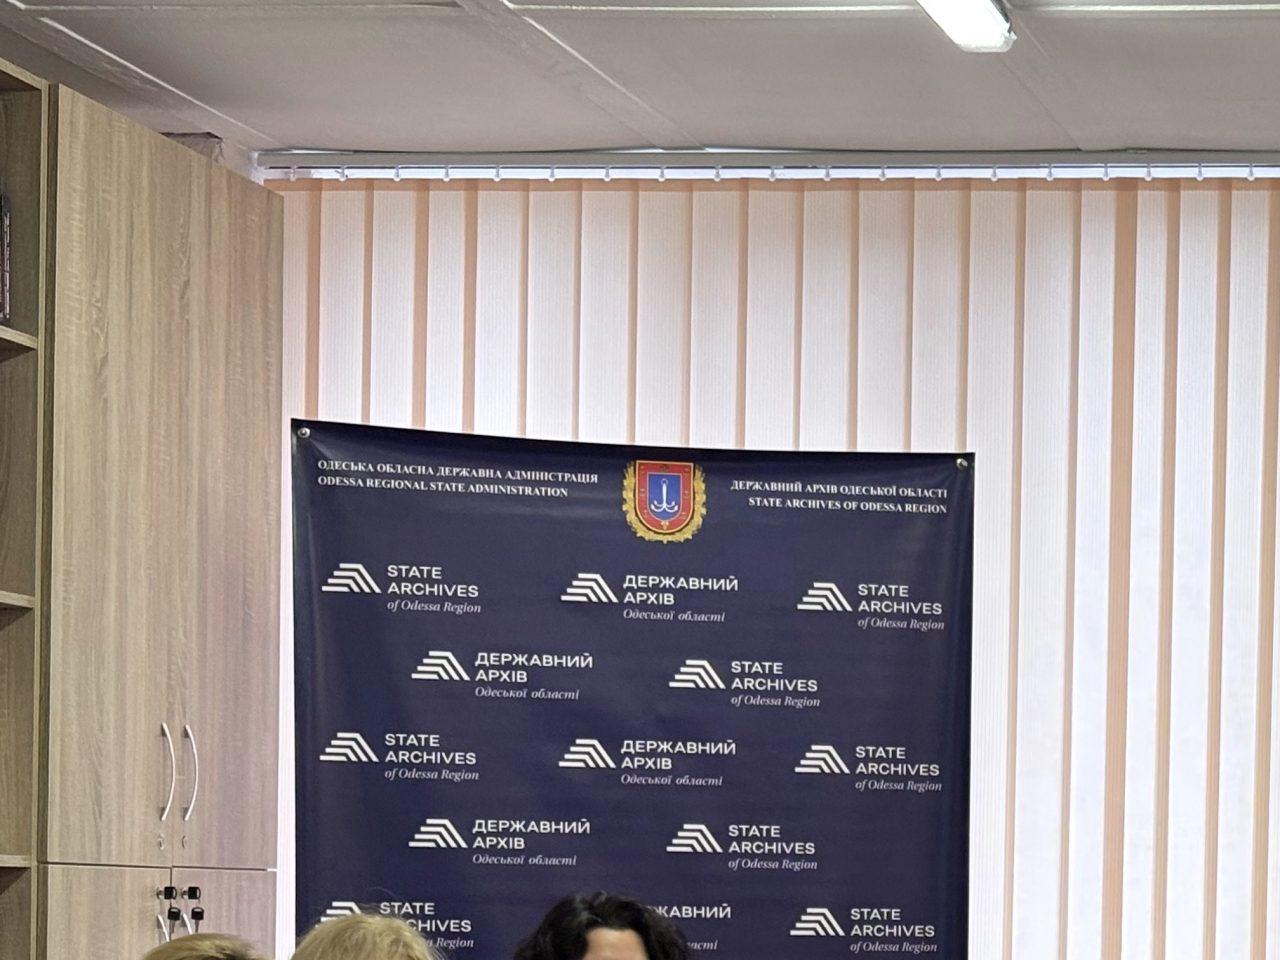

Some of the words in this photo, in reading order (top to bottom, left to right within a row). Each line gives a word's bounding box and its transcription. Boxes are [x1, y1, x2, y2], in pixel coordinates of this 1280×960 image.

[318, 460, 374, 473] ОДЕСЬКА
[377, 463, 434, 476] ОБЛАСНА
[437, 465, 502, 479] ДЕРЖАВНА
[506, 468, 598, 484] АДМІНІСТРАЦІЯ
[318, 476, 364, 487] ODESSA
[366, 478, 428, 491] REGIONAL
[430, 481, 465, 492] STATE
[468, 483, 568, 497] ADMINISTRATION
[731, 479, 802, 493] ДЕРЖАВНИЙ
[805, 484, 837, 494] АРХІВ
[840, 485, 896, 497] ОДЕСЬКОЇ
[899, 487, 947, 499] ОБЛАСТІ
[749, 497, 783, 508] STATE
[785, 498, 841, 510] ARCHIVES
[844, 501, 858, 511] OF
[860, 501, 902, 513] ODESSA
[905, 504, 947, 514] REGION
[387, 565, 442, 579] STATE
[387, 582, 479, 597] ARCHIVES
[623, 575, 738, 591] ДЕРЖАВНИЙ
[858, 583, 909, 597] STATE
[624, 592, 675, 605] АРХІВ
[387, 600, 400, 612] of
[401, 600, 440, 612] Odessa
[443, 602, 481, 615] Region
[858, 600, 942, 615] ARCHIVES
[623, 608, 675, 620] Одеської
[678, 611, 725, 622] області
[858, 617, 869, 630] of
[870, 617, 907, 629] Odessa
[910, 619, 945, 632] Region
[475, 652, 593, 668] ДЕРЖАВНИЙ
[731, 661, 783, 674] STATE
[475, 670, 528, 683] АРХІВ
[731, 678, 818, 692] ARCHIVES
[475, 686, 528, 698] Одеської
[531, 688, 579, 700] області
[731, 694, 743, 707] of
[744, 695, 781, 707] Odessa
[784, 696, 820, 709] Region
[384, 733, 440, 747] STATE
[620, 739, 736, 755] ДЕРЖАВНИЙ
[384, 750, 477, 765] ARCHIVES
[855, 746, 906, 759] STATE
[621, 757, 673, 770] АРХІВ
[855, 763, 940, 776] ARCHIVES
[384, 768, 398, 781] of
[398, 768, 438, 780] Odessa
[441, 769, 479, 782] Region
[620, 773, 673, 785] Одеської
[675, 775, 723, 786] області
[855, 779, 868, 792] of
[868, 779, 905, 791] Odessa
[906, 781, 942, 793] Region
[472, 818, 591, 835] ДЕРЖАВНИЙ
[728, 824, 781, 838] STATE
[472, 836, 526, 850] АРХІВ
[728, 841, 816, 855] ARCHIVES
[472, 853, 526, 865] Одеської
[528, 855, 577, 866] області
[728, 858, 740, 871] of
[741, 858, 779, 870] Odessa
[781, 859, 818, 873] Region
[380, 902, 435, 915] STATE
[653, 903, 731, 919] ЖАВНИЙ
[850, 908, 902, 921] STATE
[850, 925, 935, 937] ARCHIVES
[436, 937, 475, 950] Region
[850, 941, 863, 954] of
[862, 941, 899, 953] Odessa
[902, 942, 938, 955] Region
